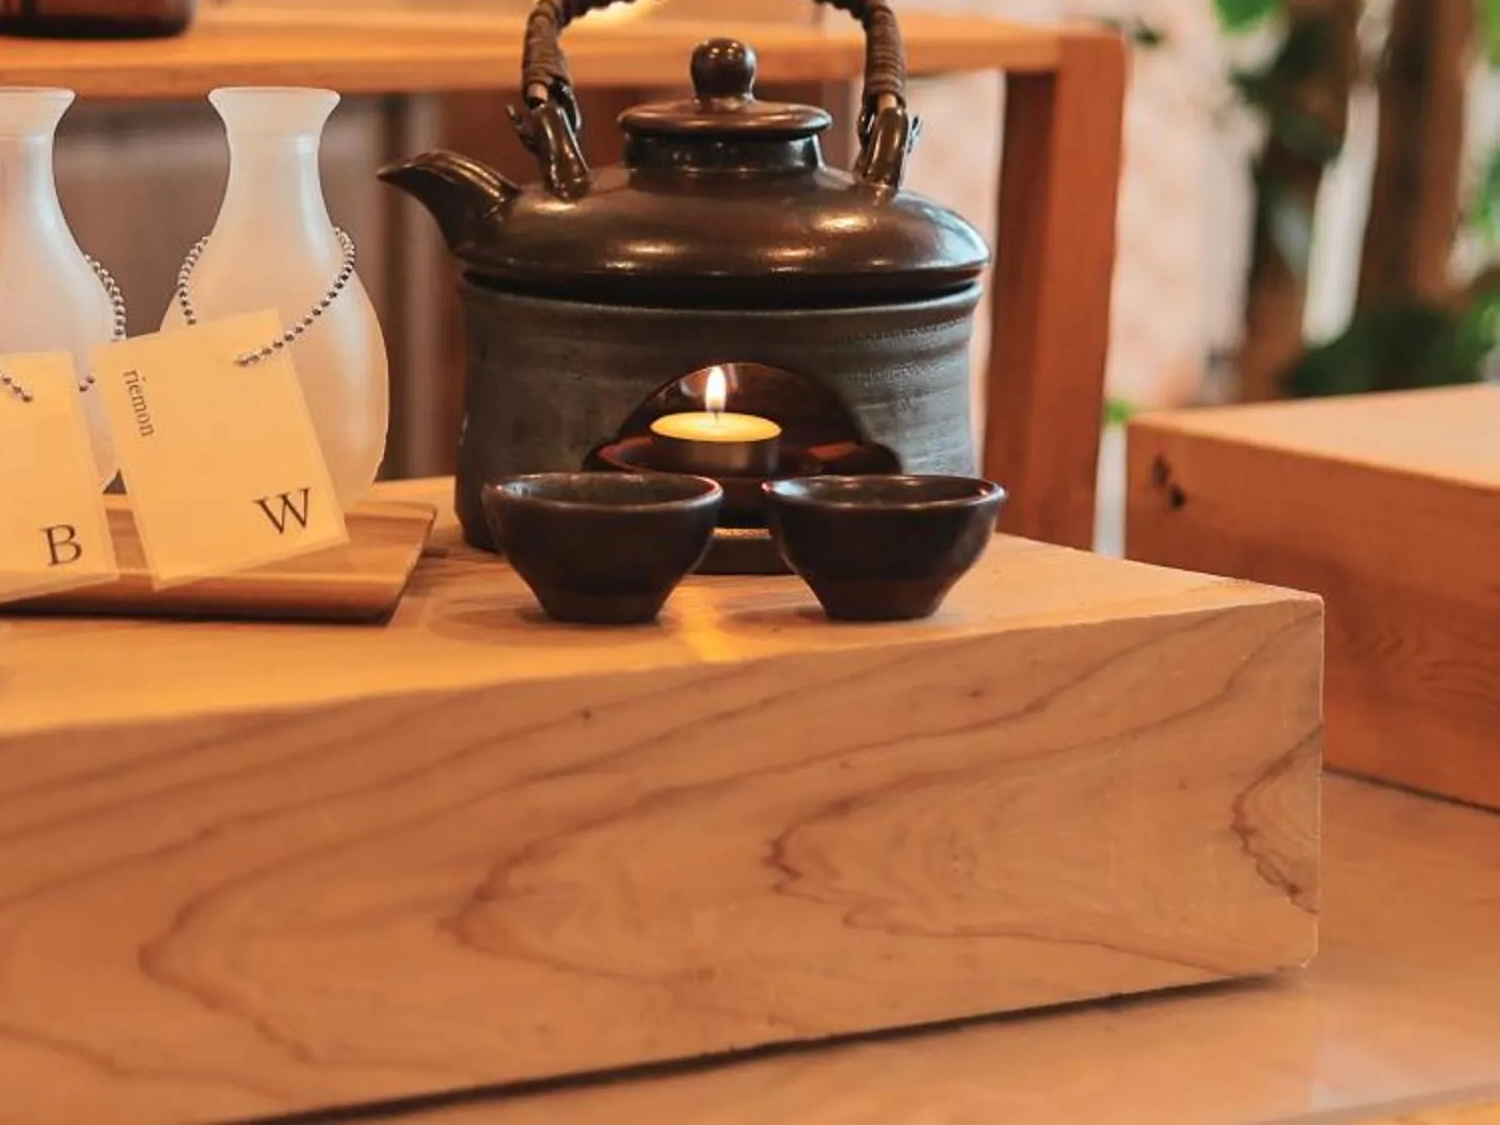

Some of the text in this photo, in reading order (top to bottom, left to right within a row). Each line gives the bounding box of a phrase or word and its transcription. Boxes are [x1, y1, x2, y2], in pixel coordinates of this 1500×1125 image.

[122, 369, 156, 437] riemon
[252, 487, 312, 536] W
[40, 523, 83, 567] B
